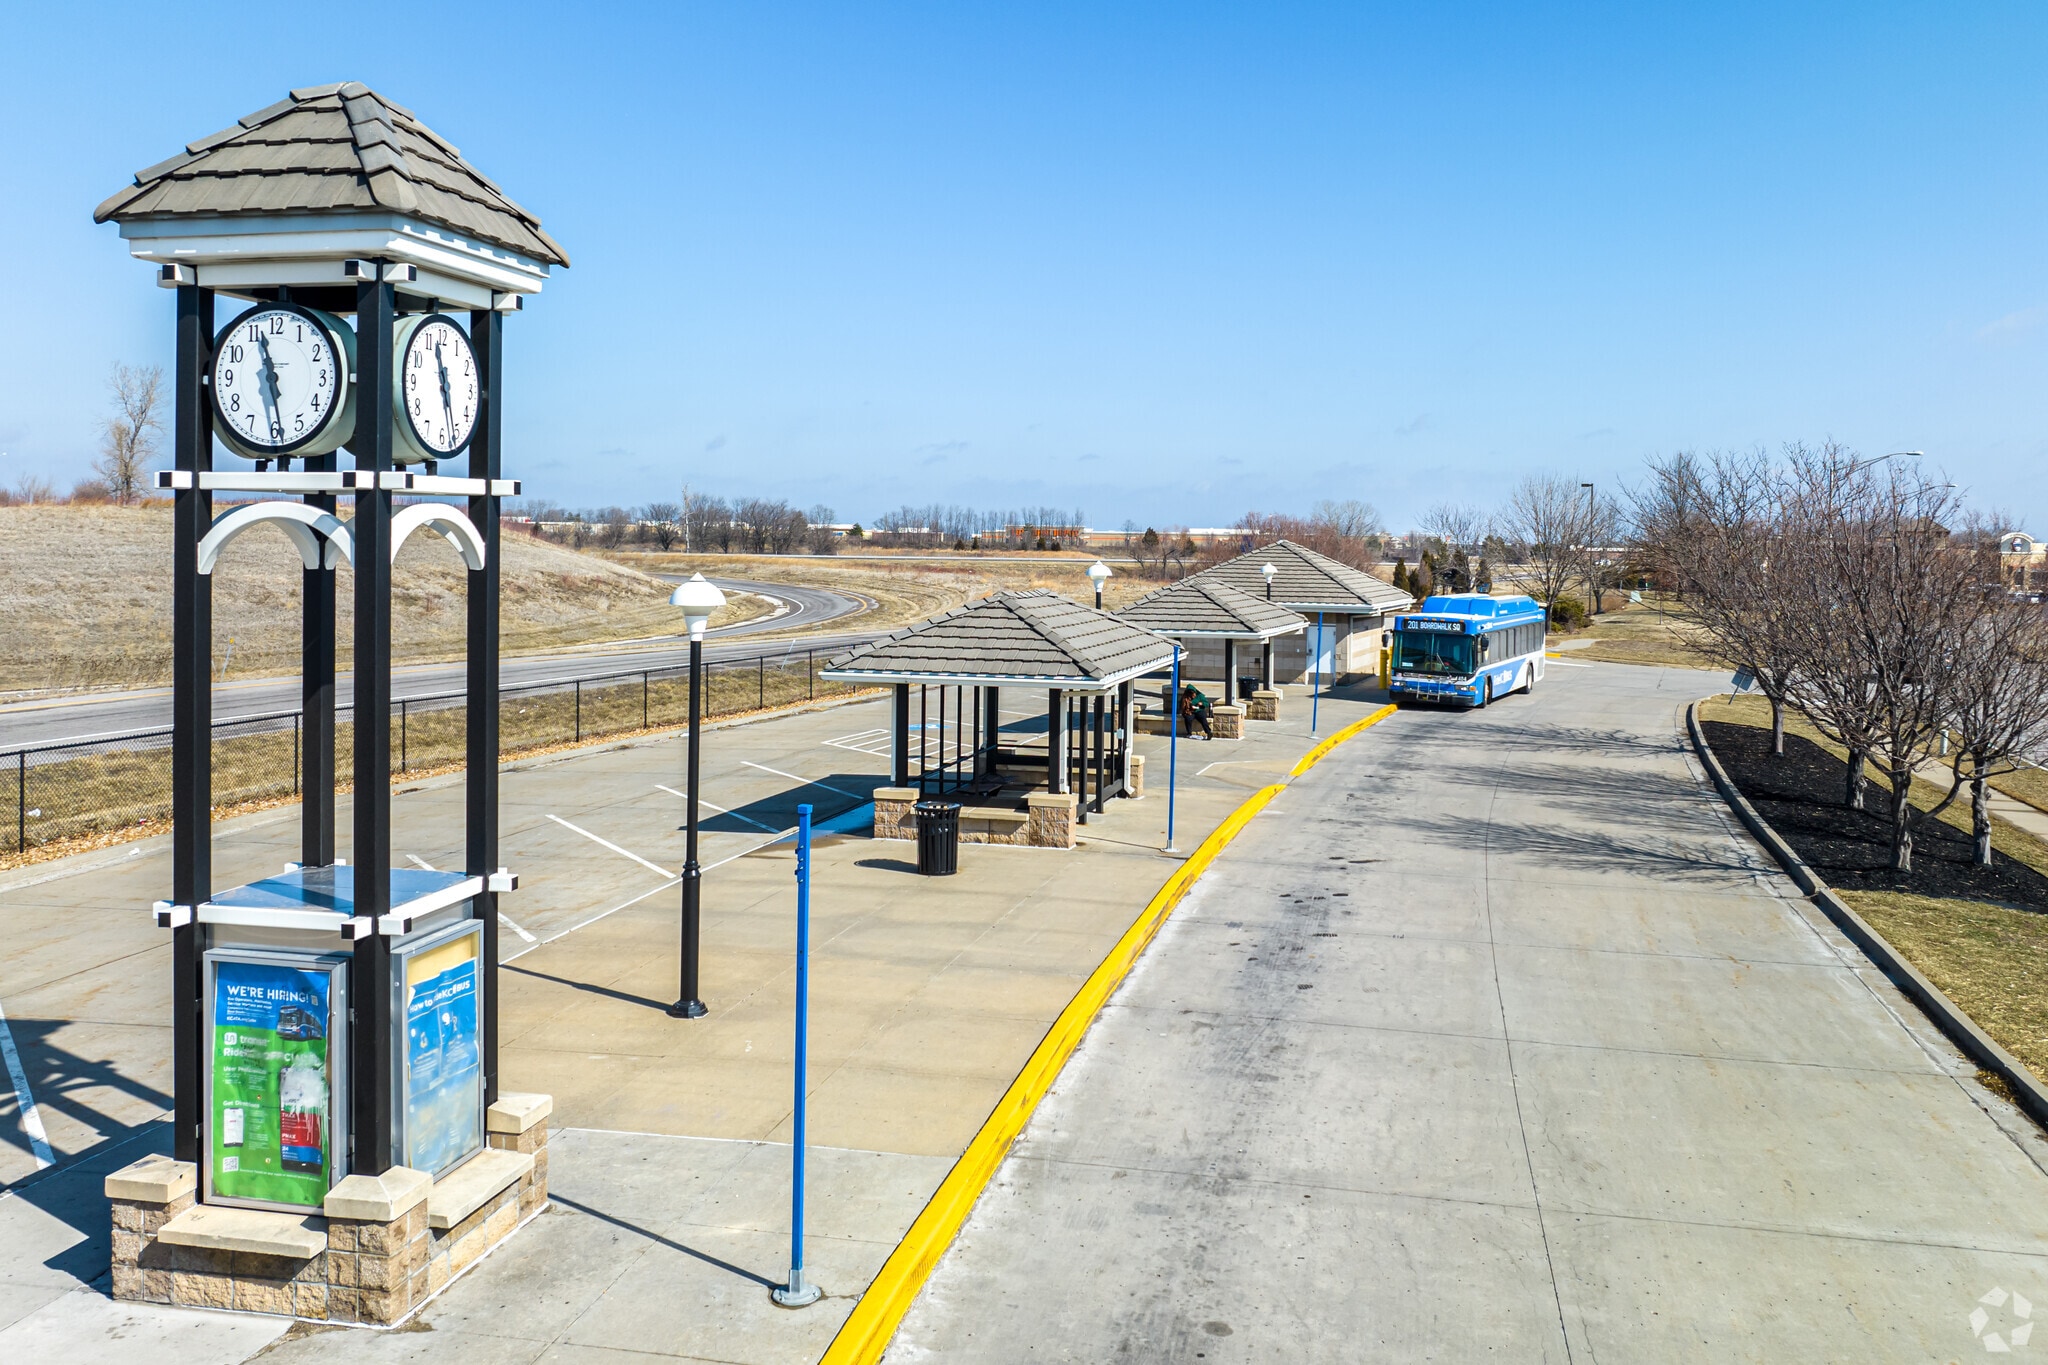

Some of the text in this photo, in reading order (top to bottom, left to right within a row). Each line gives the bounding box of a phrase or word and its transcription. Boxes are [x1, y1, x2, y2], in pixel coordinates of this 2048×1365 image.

[248, 324, 259, 342] 11
[269, 317, 284, 335] 12
[296, 324, 302, 342] 1
[425, 333, 432, 350] 11
[438, 329, 447, 346] 12
[230, 345, 243, 363] 10
[312, 343, 321, 362] 2
[455, 340, 458, 356] 1
[414, 350, 422, 368] 10
[464, 360, 469, 376] 2
[225, 369, 233, 387] 9
[319, 369, 326, 387] 3
[411, 374, 416, 391] 9
[468, 384, 473, 400] 3
[230, 393, 240, 412] 8
[311, 393, 320, 412] 4
[415, 398, 421, 416] 8
[294, 413, 304, 432] 5
[463, 405, 469, 422] 4
[245, 414, 255, 433] 7
[270, 420, 279, 439] 6
[424, 420, 430, 437] 7
[454, 423, 460, 440] 5
[440, 428, 444, 445] 6
[1407, 620, 1461, 631] 201 BOARDWALK SQ
[227, 985, 309, 1003] WE'RE HIRING!
[409, 1001, 424, 1013] How
[424, 999, 433, 1007] to
